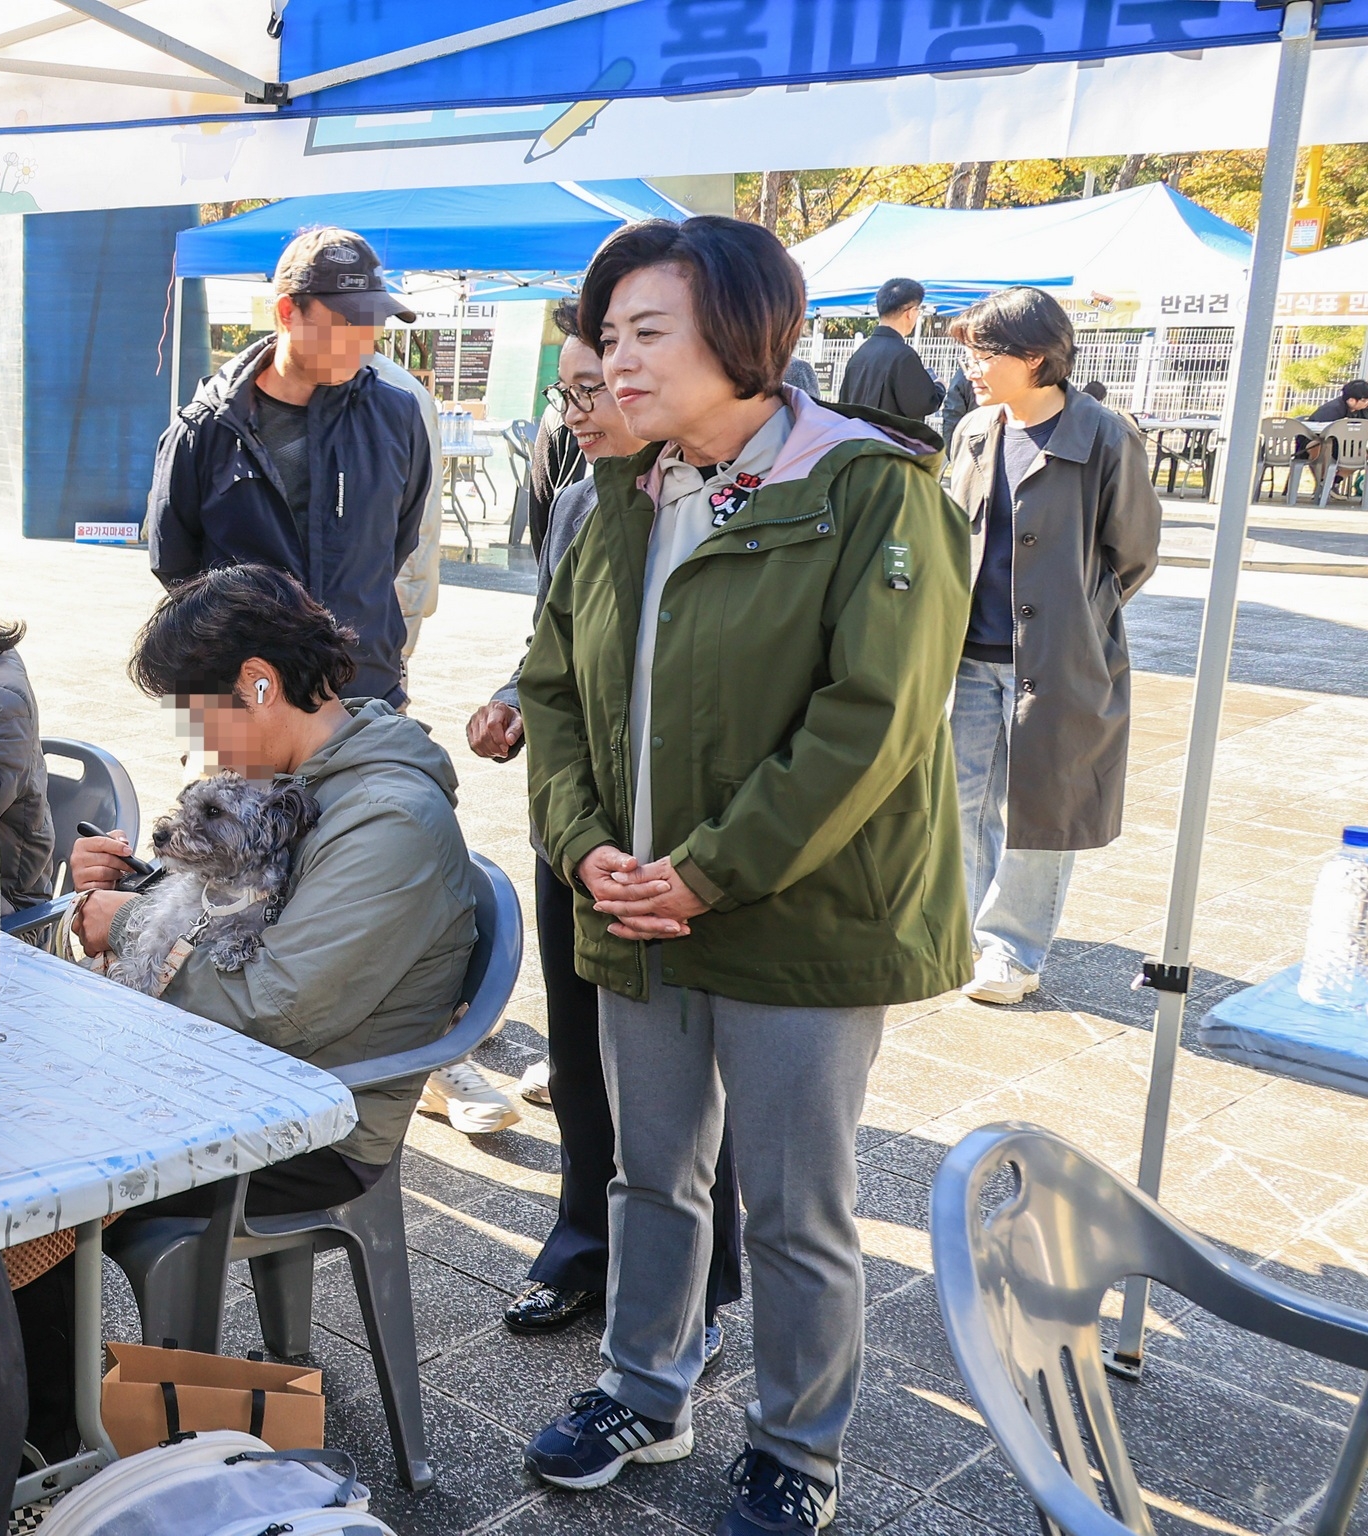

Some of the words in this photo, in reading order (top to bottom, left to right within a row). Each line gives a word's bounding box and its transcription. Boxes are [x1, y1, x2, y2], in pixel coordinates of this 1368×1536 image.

[340, 276, 365, 287] Jeep
[1161, 293, 1229, 314] 반려견
[77, 526, 137, 536] 올라가지마세요!
